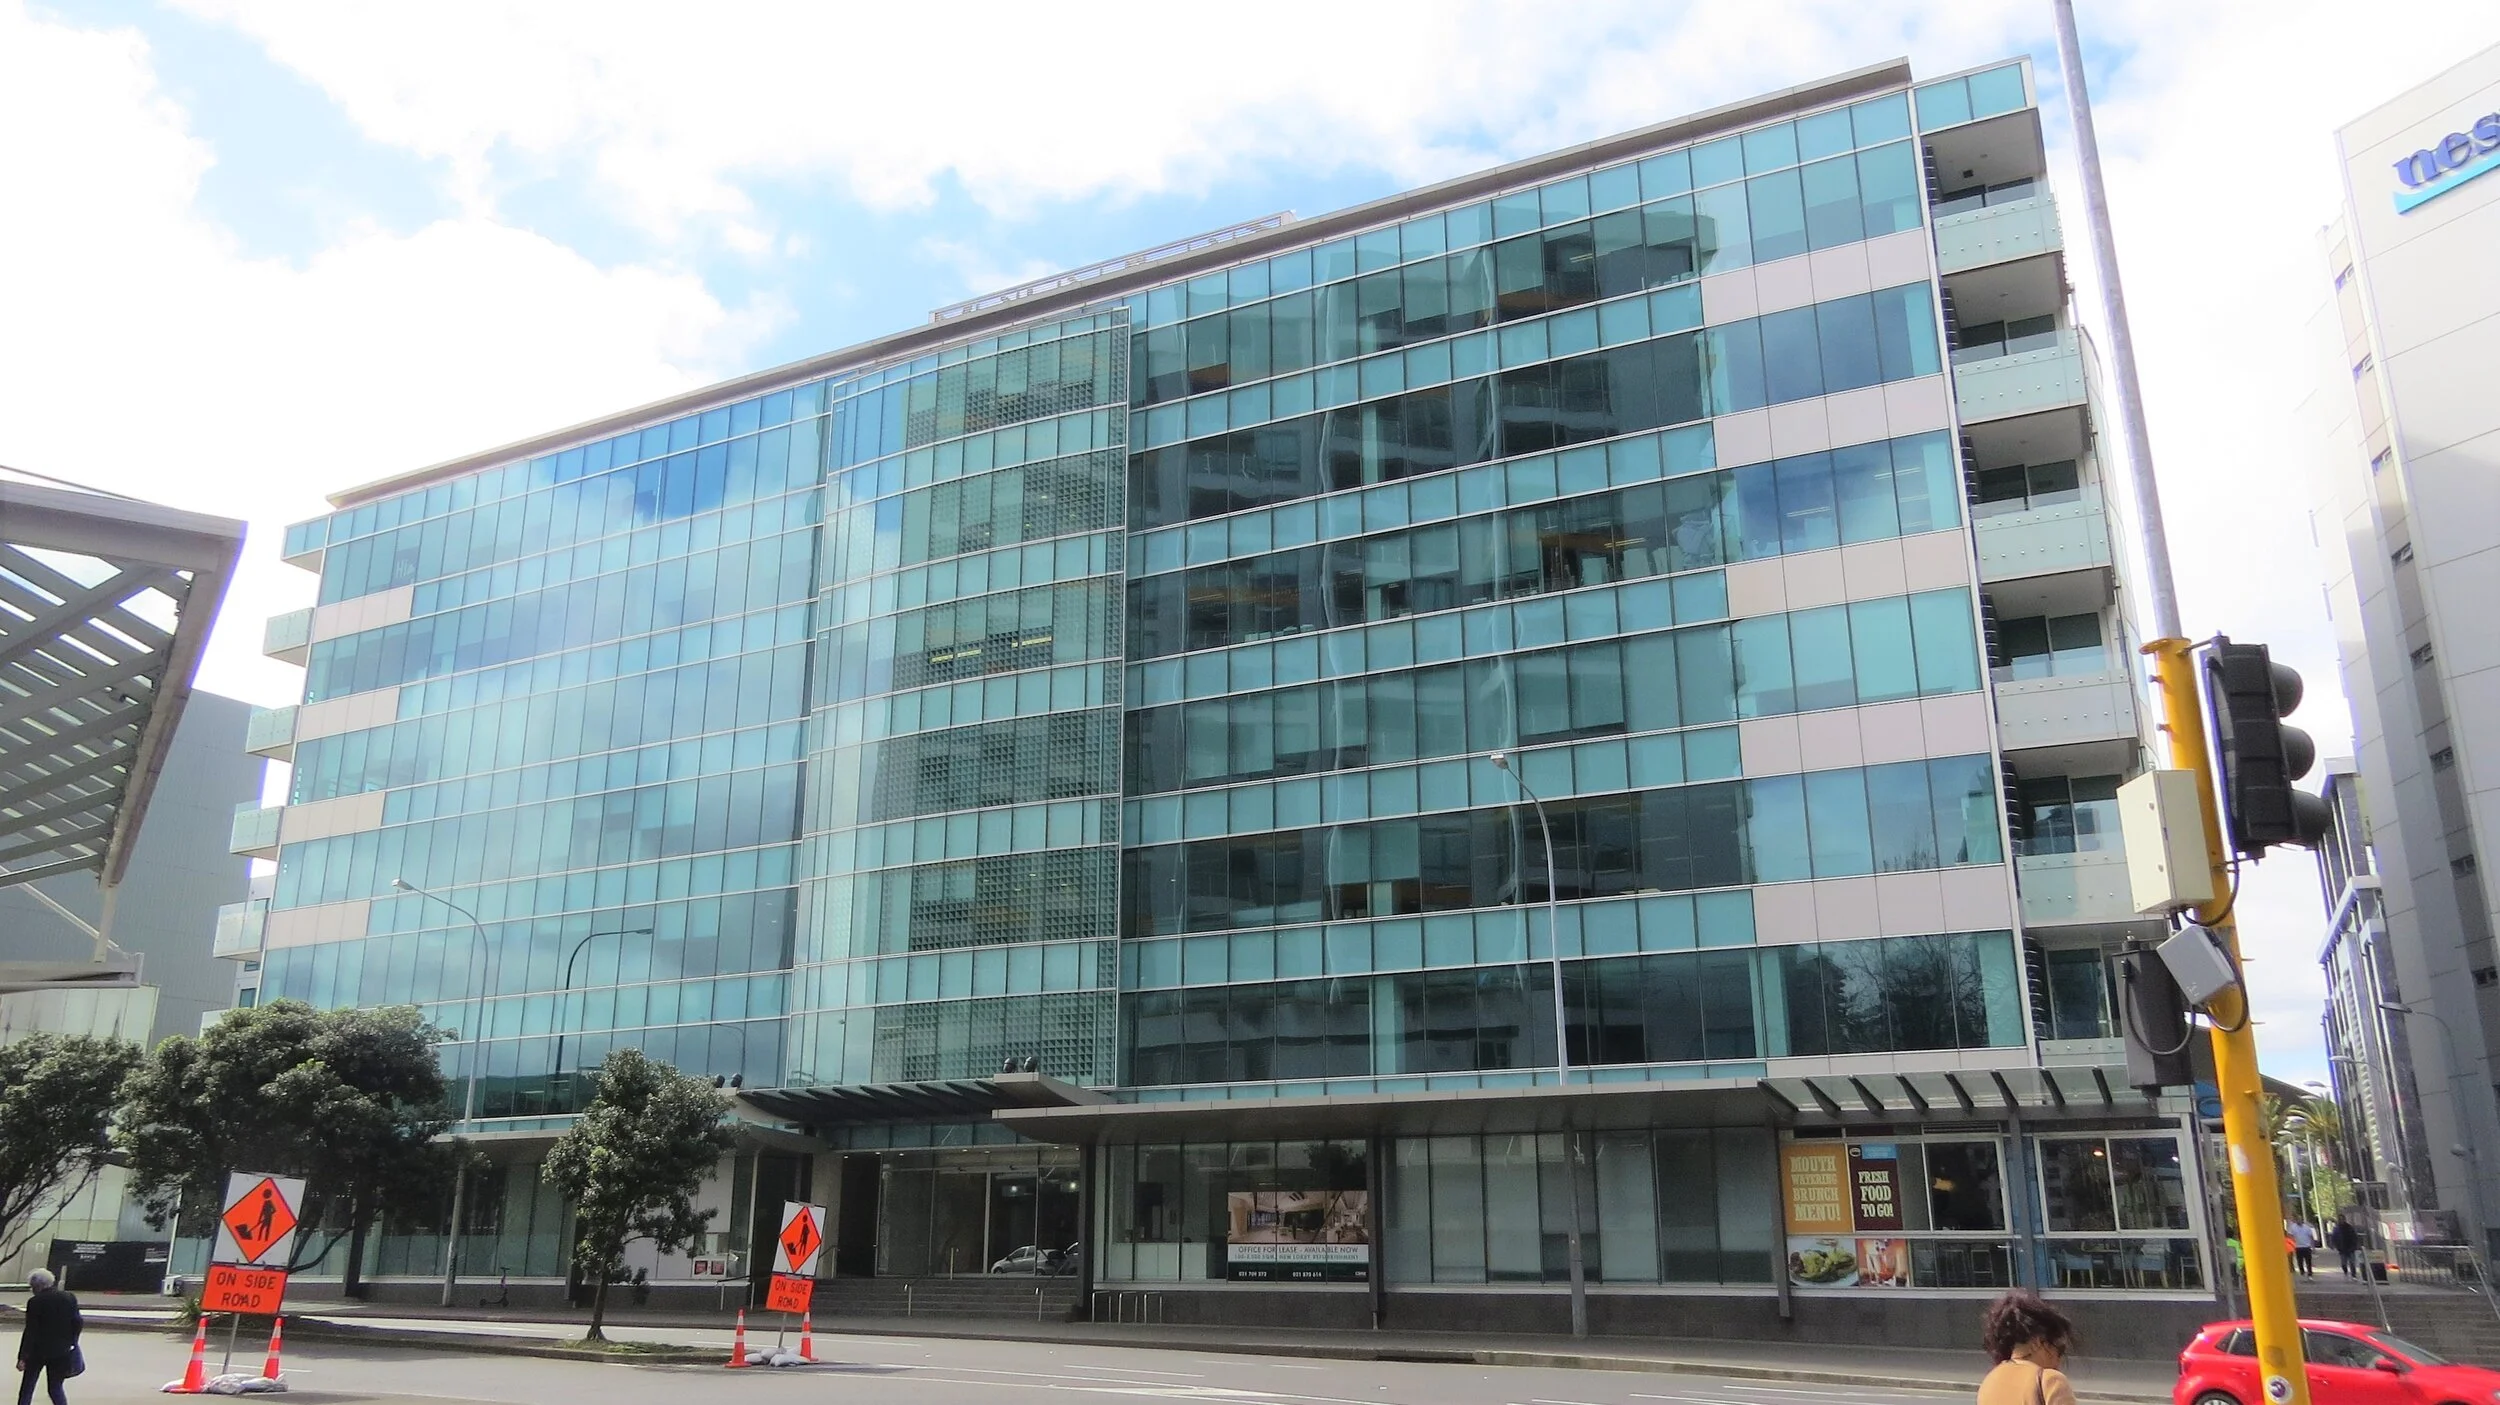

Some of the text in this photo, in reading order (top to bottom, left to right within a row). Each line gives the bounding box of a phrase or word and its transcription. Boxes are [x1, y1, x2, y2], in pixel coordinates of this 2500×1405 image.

[1790, 1156, 1836, 1172] MOUTH
[1791, 1173, 1837, 1185] WATERING
[1858, 1171, 1889, 1183] FRESH
[1793, 1187, 1839, 1201] BRUNCH
[1860, 1185, 1892, 1201] FOOD
[1795, 1203, 1840, 1221] MENU!
[1861, 1203, 1894, 1217] TO GO!
[216, 1272, 276, 1290] ON SIDE
[775, 1280, 808, 1295] ON SIDE
[221, 1293, 260, 1308] ROAD
[777, 1296, 799, 1309] ROAD
